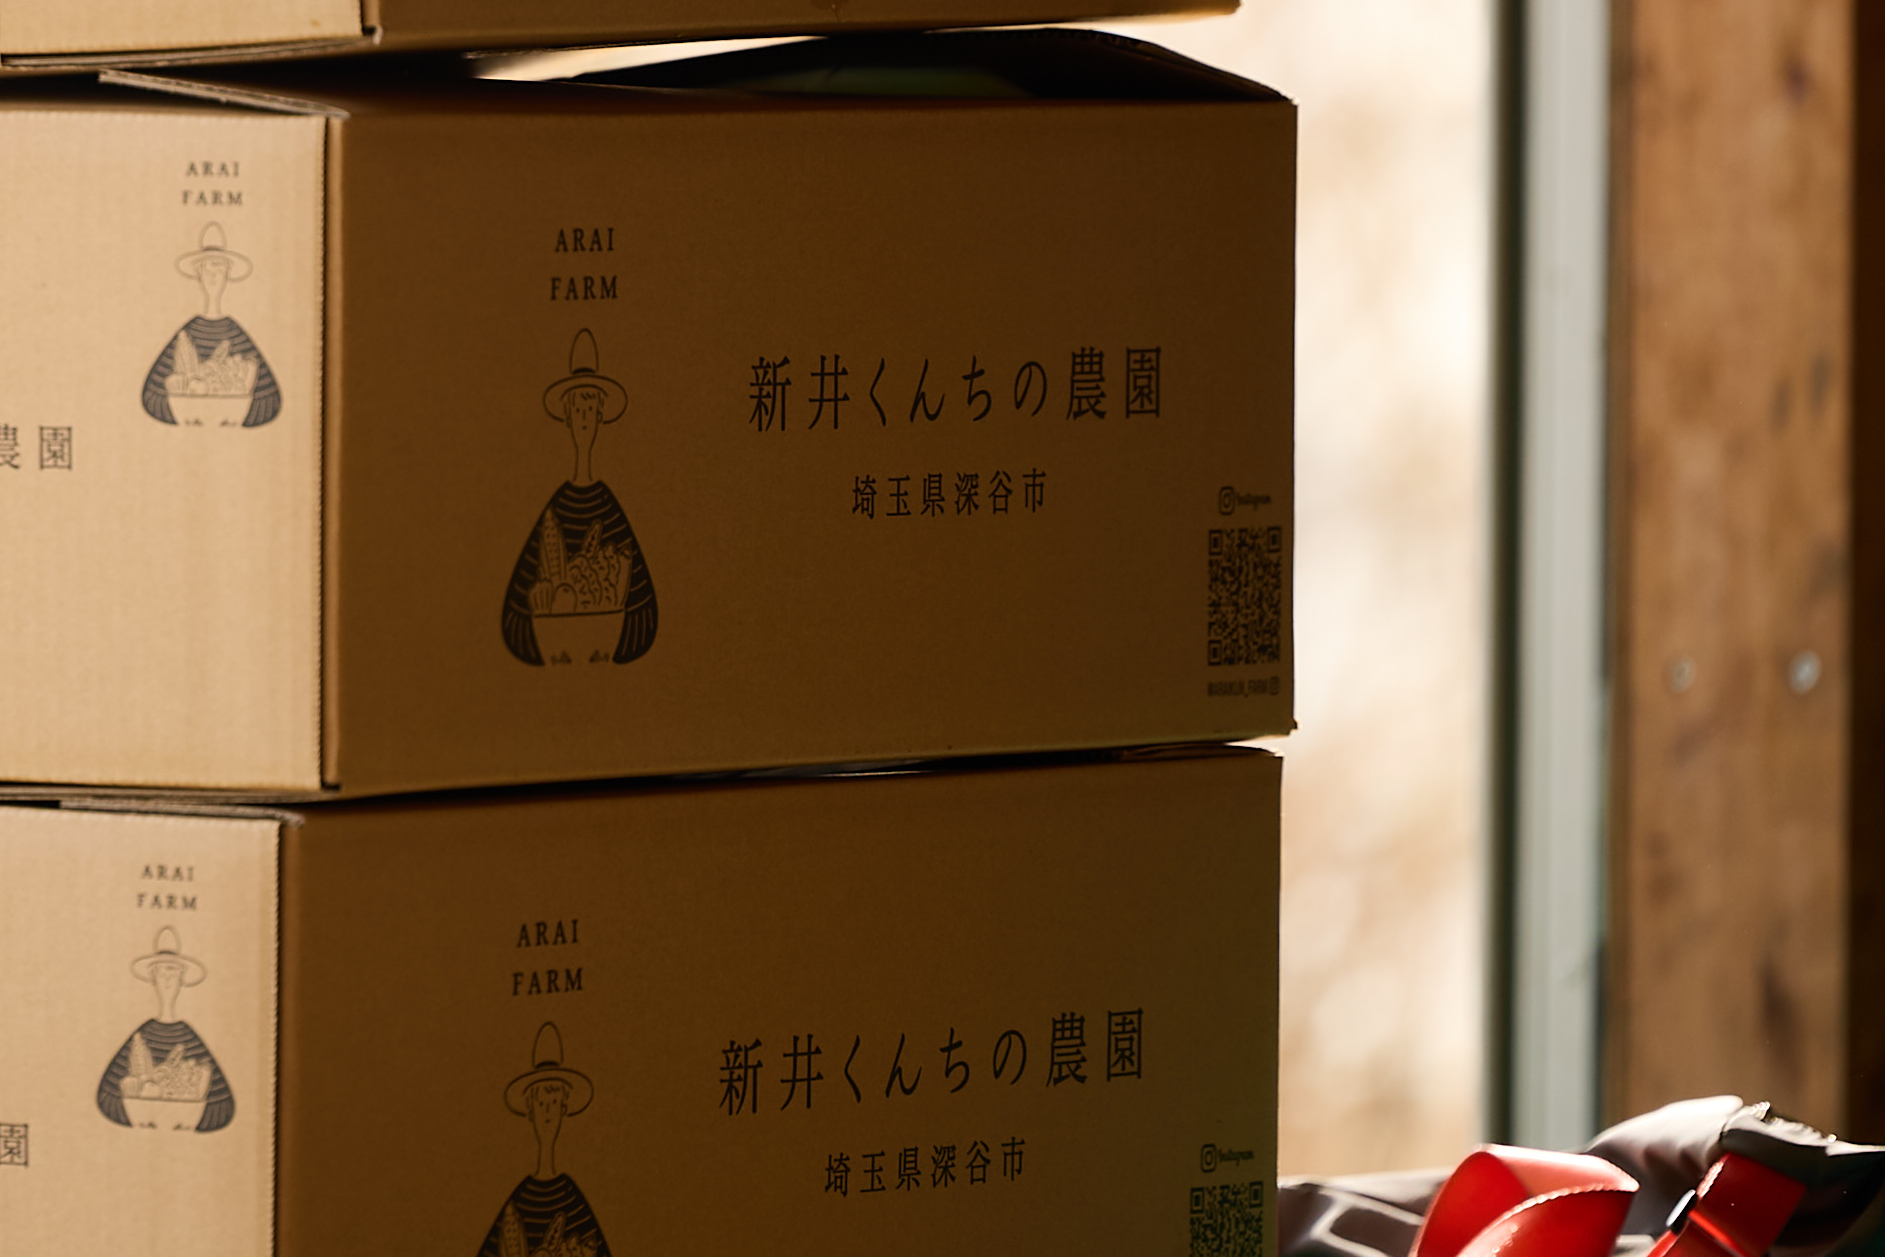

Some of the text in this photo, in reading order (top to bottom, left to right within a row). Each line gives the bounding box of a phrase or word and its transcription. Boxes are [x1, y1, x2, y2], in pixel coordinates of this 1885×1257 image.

[186, 161, 239, 177] ARAI
[182, 190, 242, 205] FARM
[555, 228, 614, 252] ARAI
[551, 275, 617, 301] FARM
[749, 347, 1161, 432] 新井くんちの農園
[852, 468, 1046, 520] 埼玉県深谷市
[142, 864, 193, 881] ARAI
[137, 893, 197, 910] FARM
[517, 919, 578, 948] ARAI
[513, 967, 583, 996] FARM
[719, 1008, 1143, 1116] 新井くんちの農園
[825, 1137, 1025, 1197] 埼玉県深谷市
